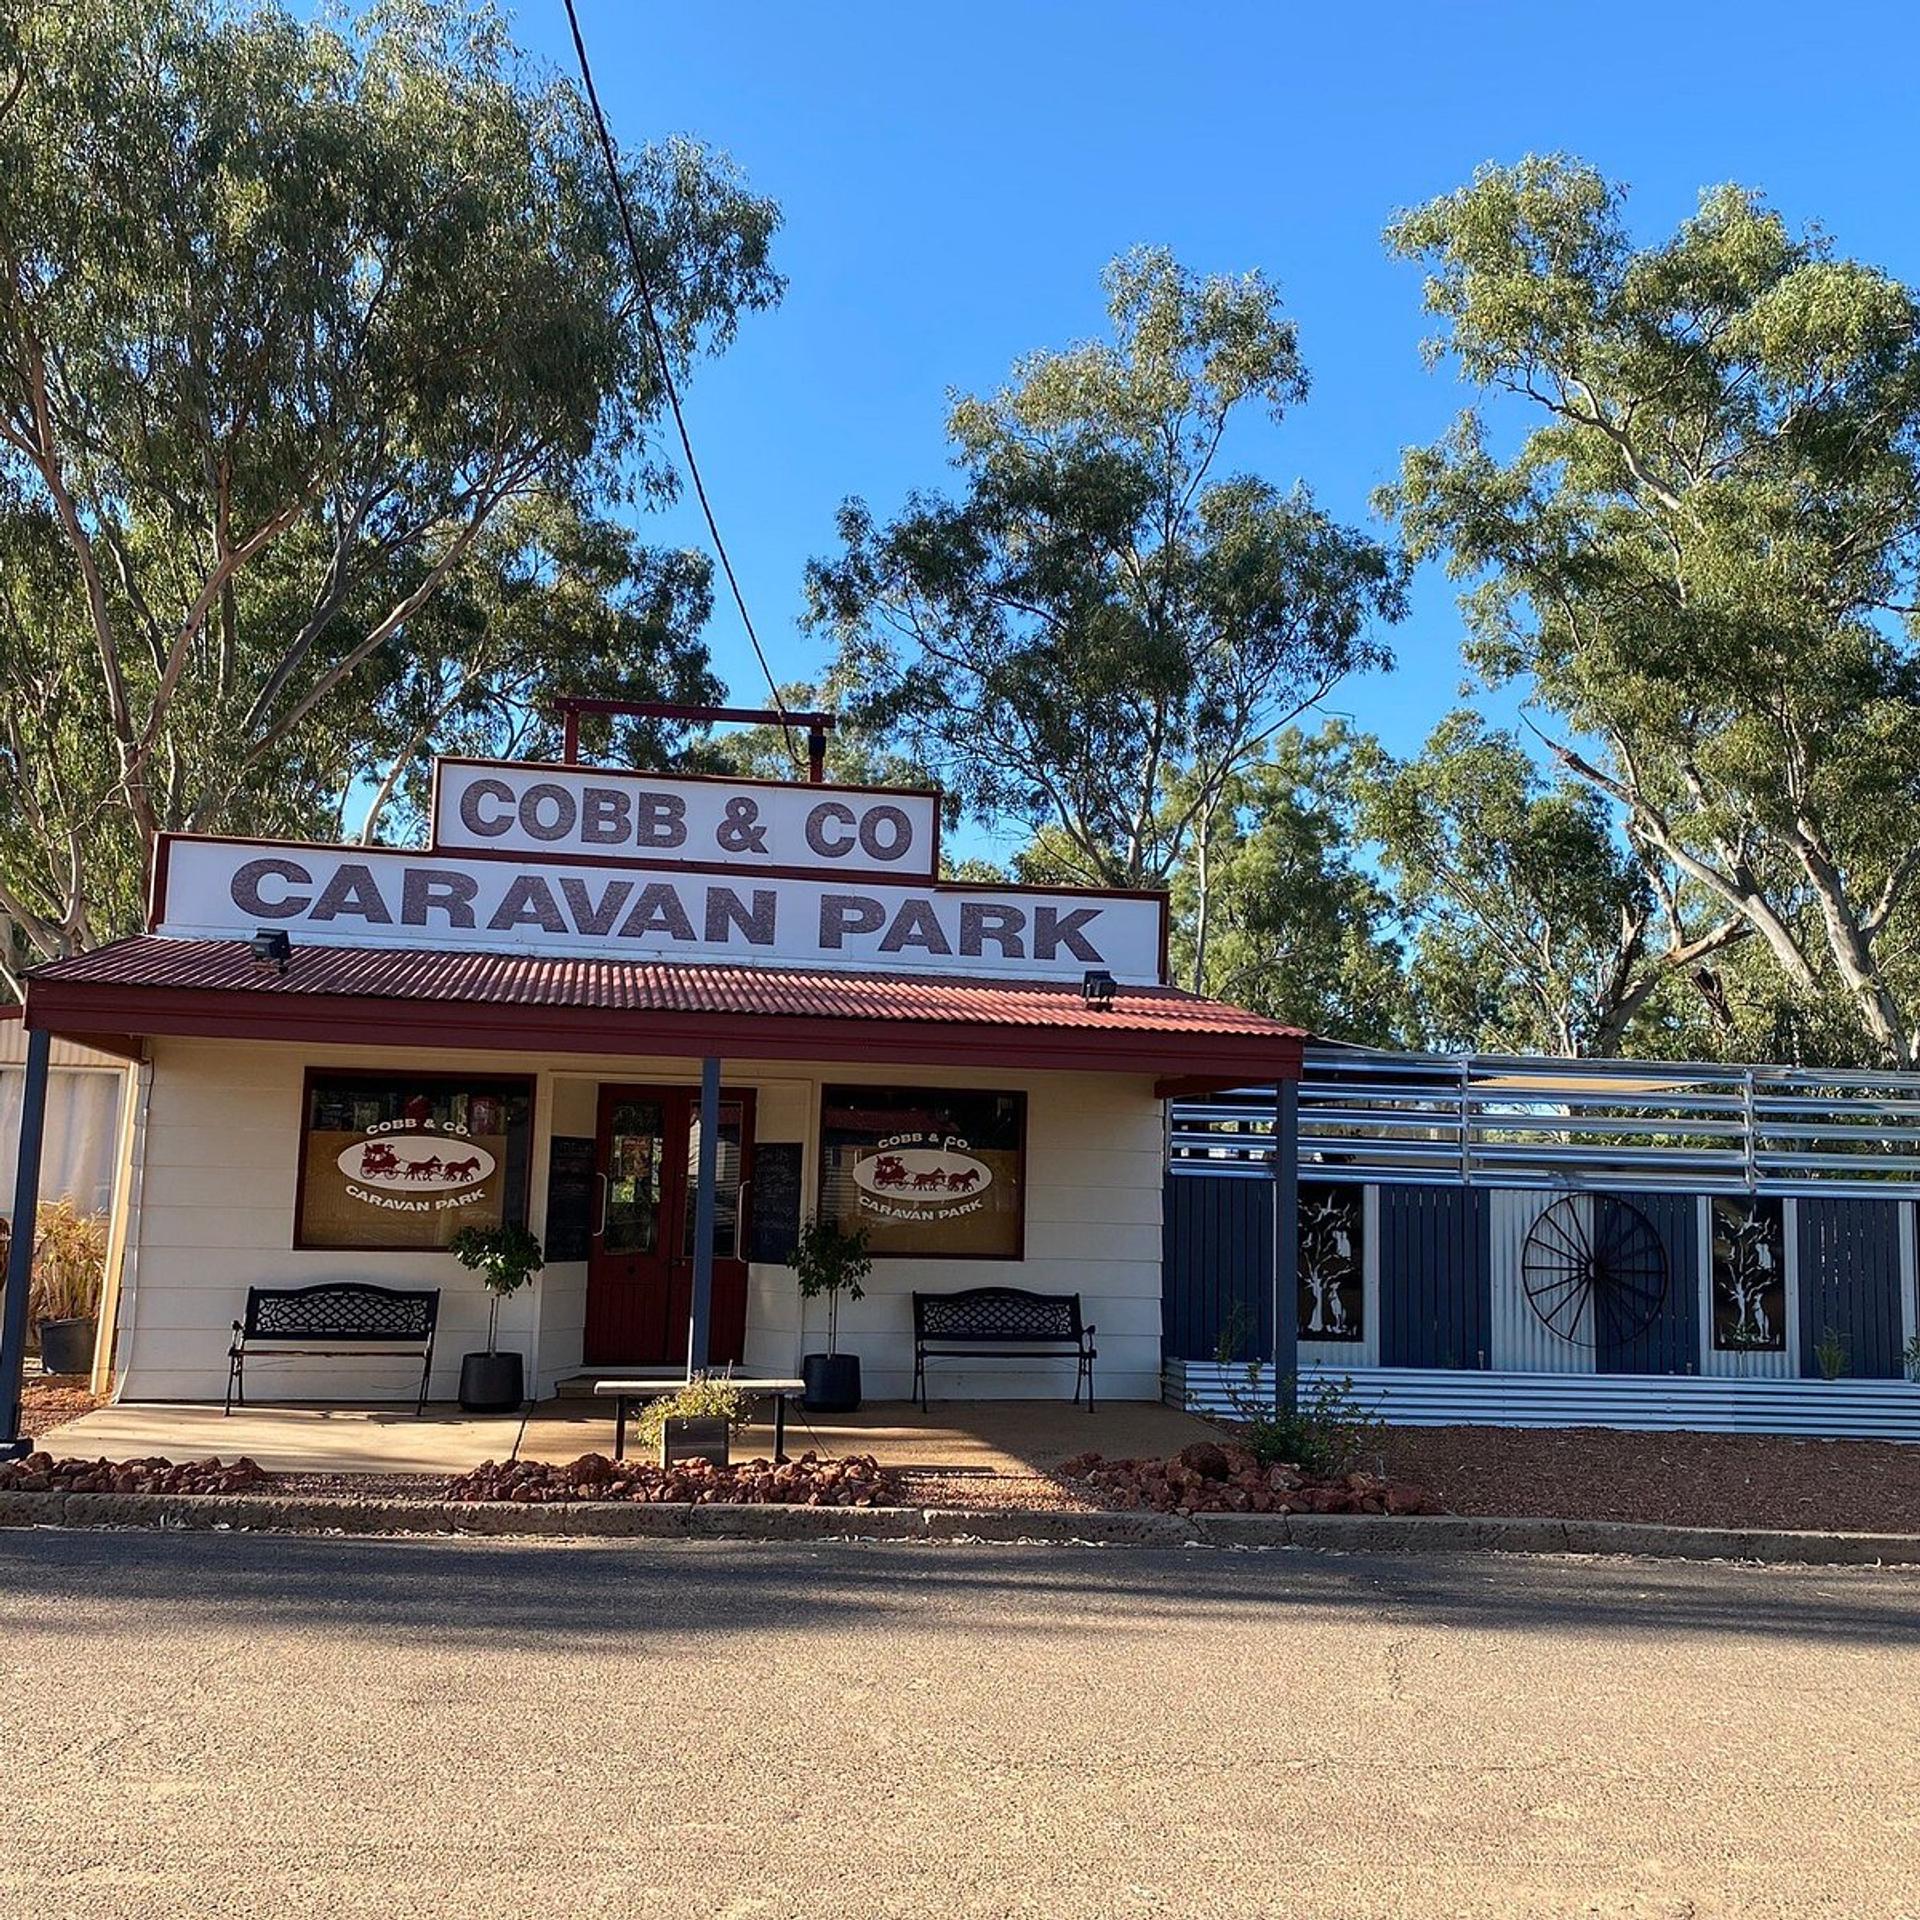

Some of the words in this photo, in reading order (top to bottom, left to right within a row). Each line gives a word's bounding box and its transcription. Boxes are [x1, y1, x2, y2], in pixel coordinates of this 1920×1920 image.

[459, 779, 688, 849] COBB
[716, 796, 769, 854] &
[805, 801, 913, 862] CO
[230, 859, 777, 946] CARAVAN
[819, 894, 1105, 963] PARK
[366, 1118, 417, 1135] COBB
[423, 1118, 436, 1129] &
[442, 1121, 472, 1138] CO.
[877, 1132, 923, 1149] COBB
[928, 1133, 939, 1143] &
[945, 1136, 971, 1151] CO.
[345, 1185, 430, 1212] CARAVAN
[435, 1188, 486, 1211] PARK
[858, 1195, 935, 1221] CARAVAN
[938, 1198, 984, 1219] PARK
